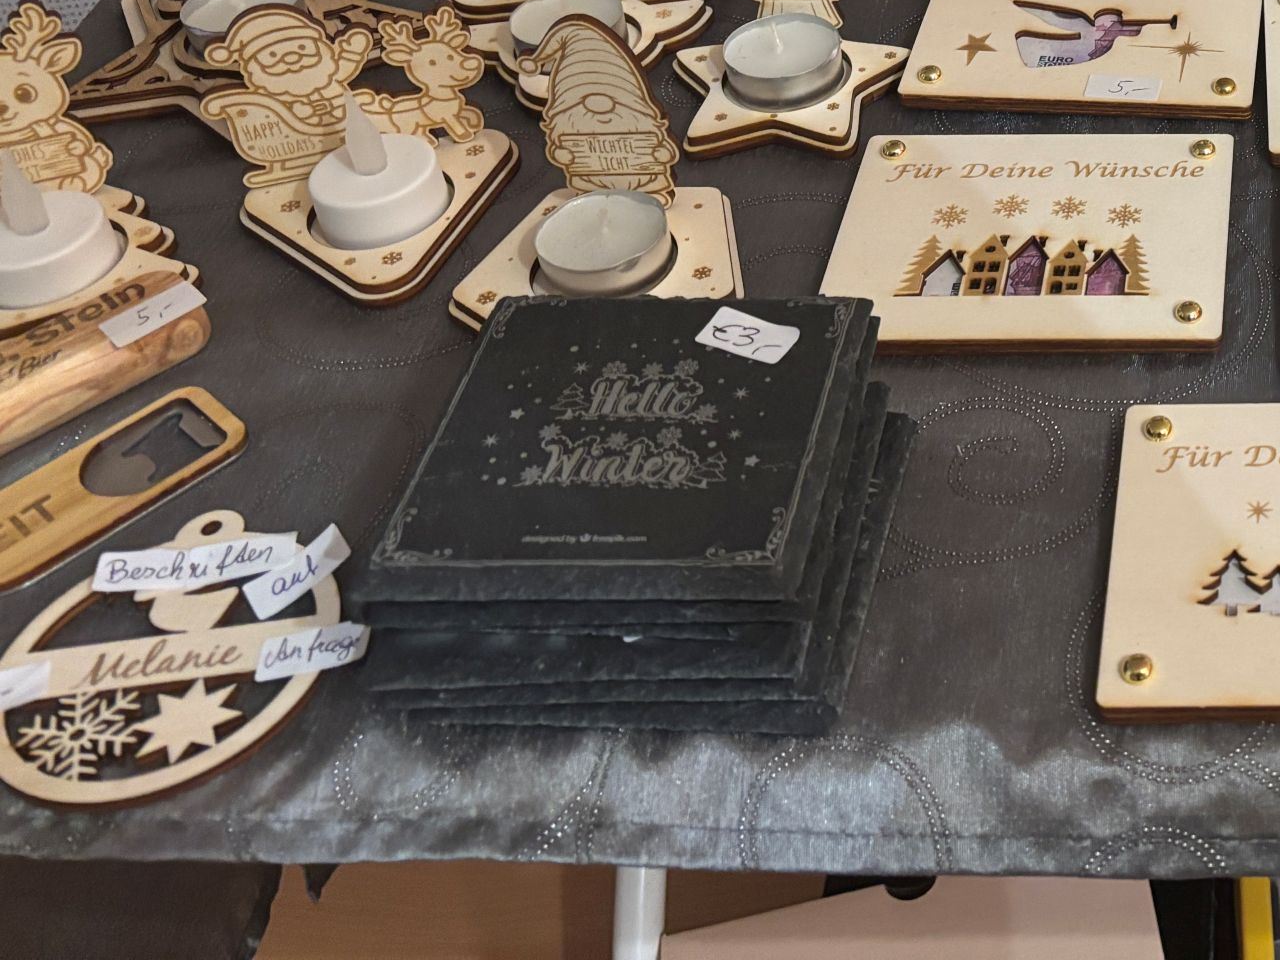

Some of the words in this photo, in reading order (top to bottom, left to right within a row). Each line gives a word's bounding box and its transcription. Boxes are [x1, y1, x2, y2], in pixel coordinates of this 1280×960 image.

[1038, 55, 1074, 63] EURO
[1107, 79, 1149, 96] 5,-
[241, 120, 283, 143] HAPPY
[584, 136, 636, 155] WICHTEL
[598, 155, 630, 172] LICHT
[885, 159, 952, 184] Für
[961, 160, 1055, 181] Deine
[1063, 159, 1206, 180] Wünsche
[137, 302, 173, 327] 5,-
[590, 378, 698, 416] Hello
[539, 442, 694, 483] Winter
[1153, 443, 1232, 473] Für
[0, 494, 55, 538] IT
[85, 641, 244, 689] Melanie
